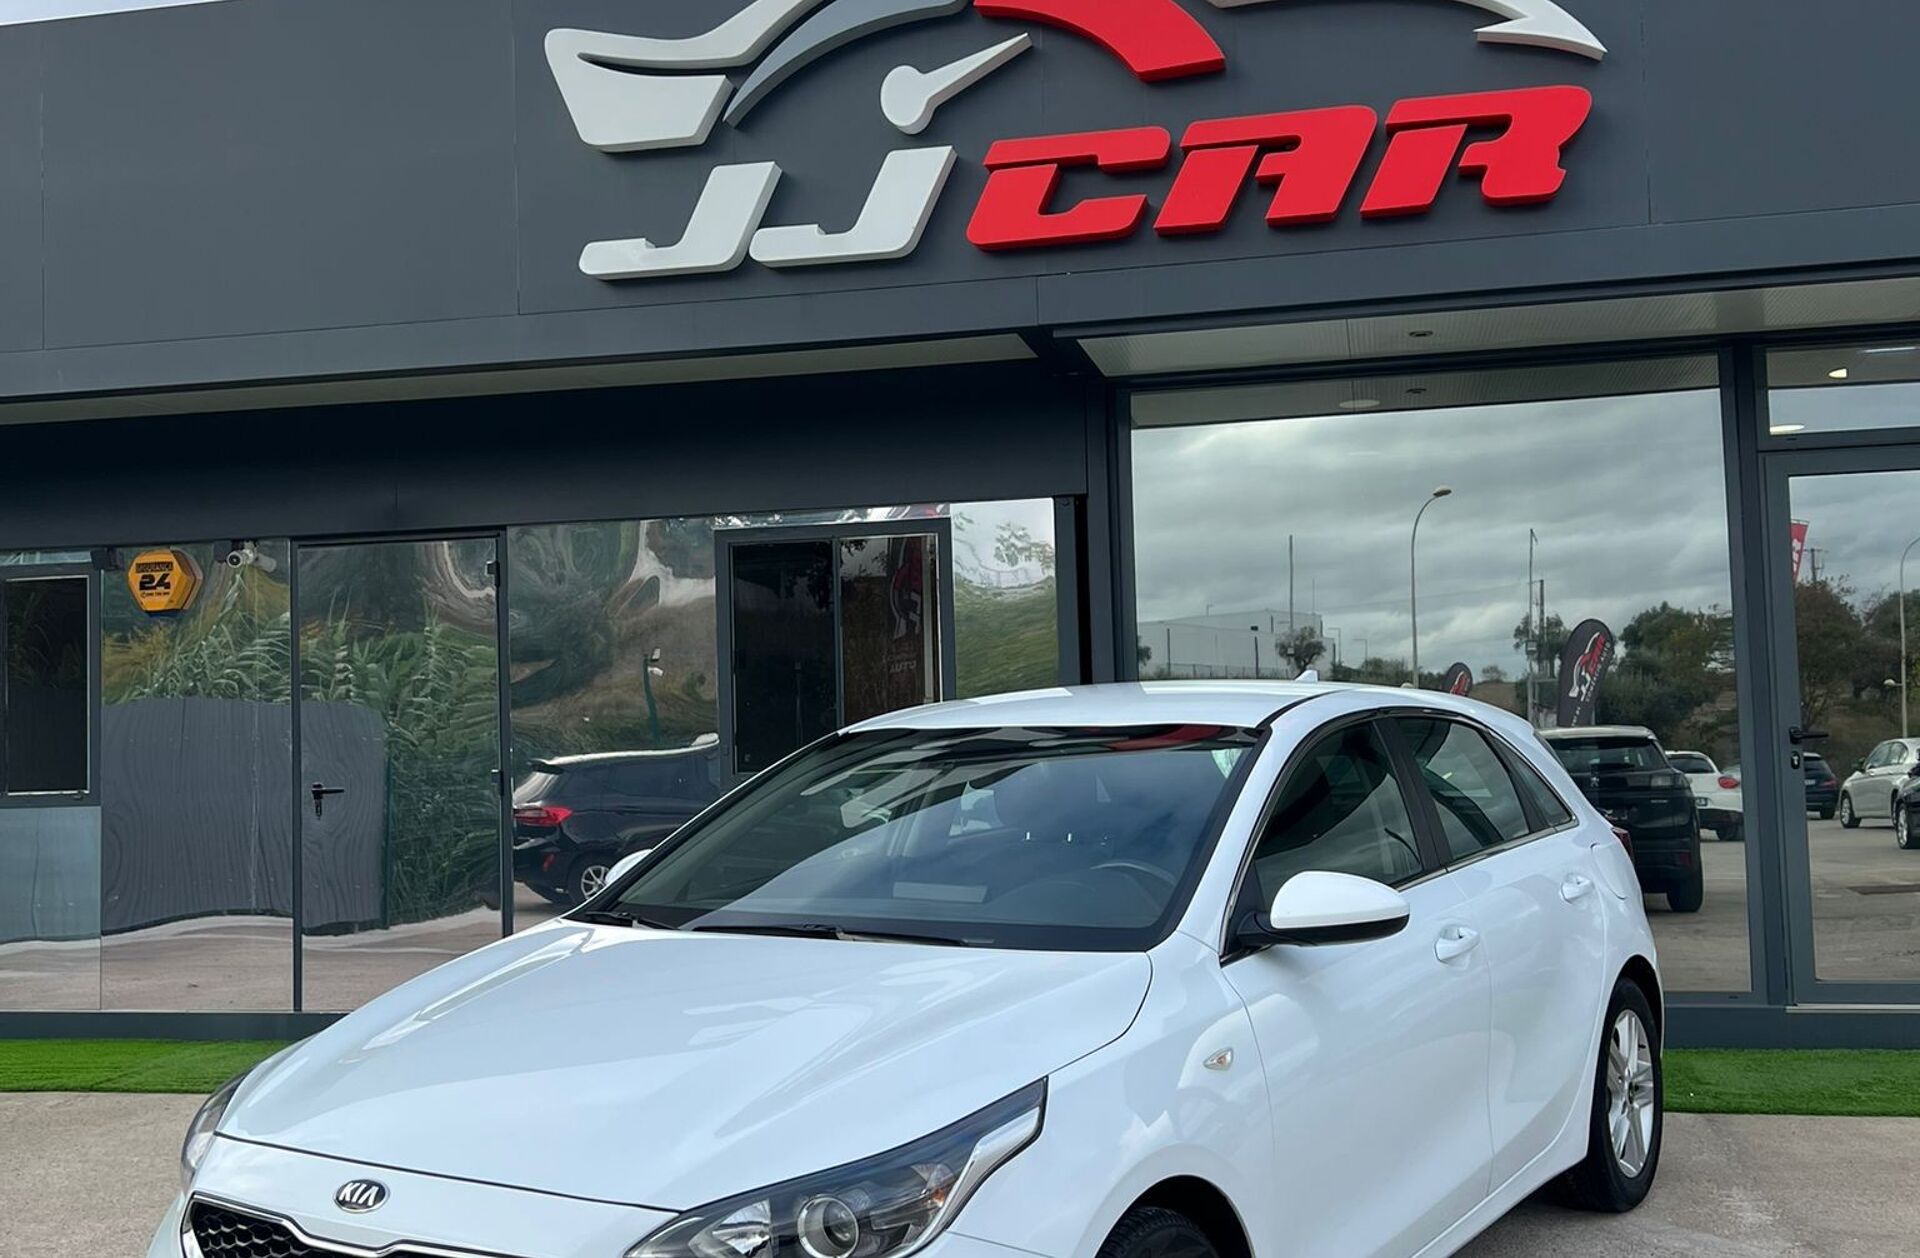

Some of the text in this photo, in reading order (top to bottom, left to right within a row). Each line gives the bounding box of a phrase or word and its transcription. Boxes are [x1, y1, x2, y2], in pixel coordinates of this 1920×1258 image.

[966, 85, 1592, 253] CAR
[139, 573, 171, 590] 24
[339, 1182, 379, 1206] KIA
